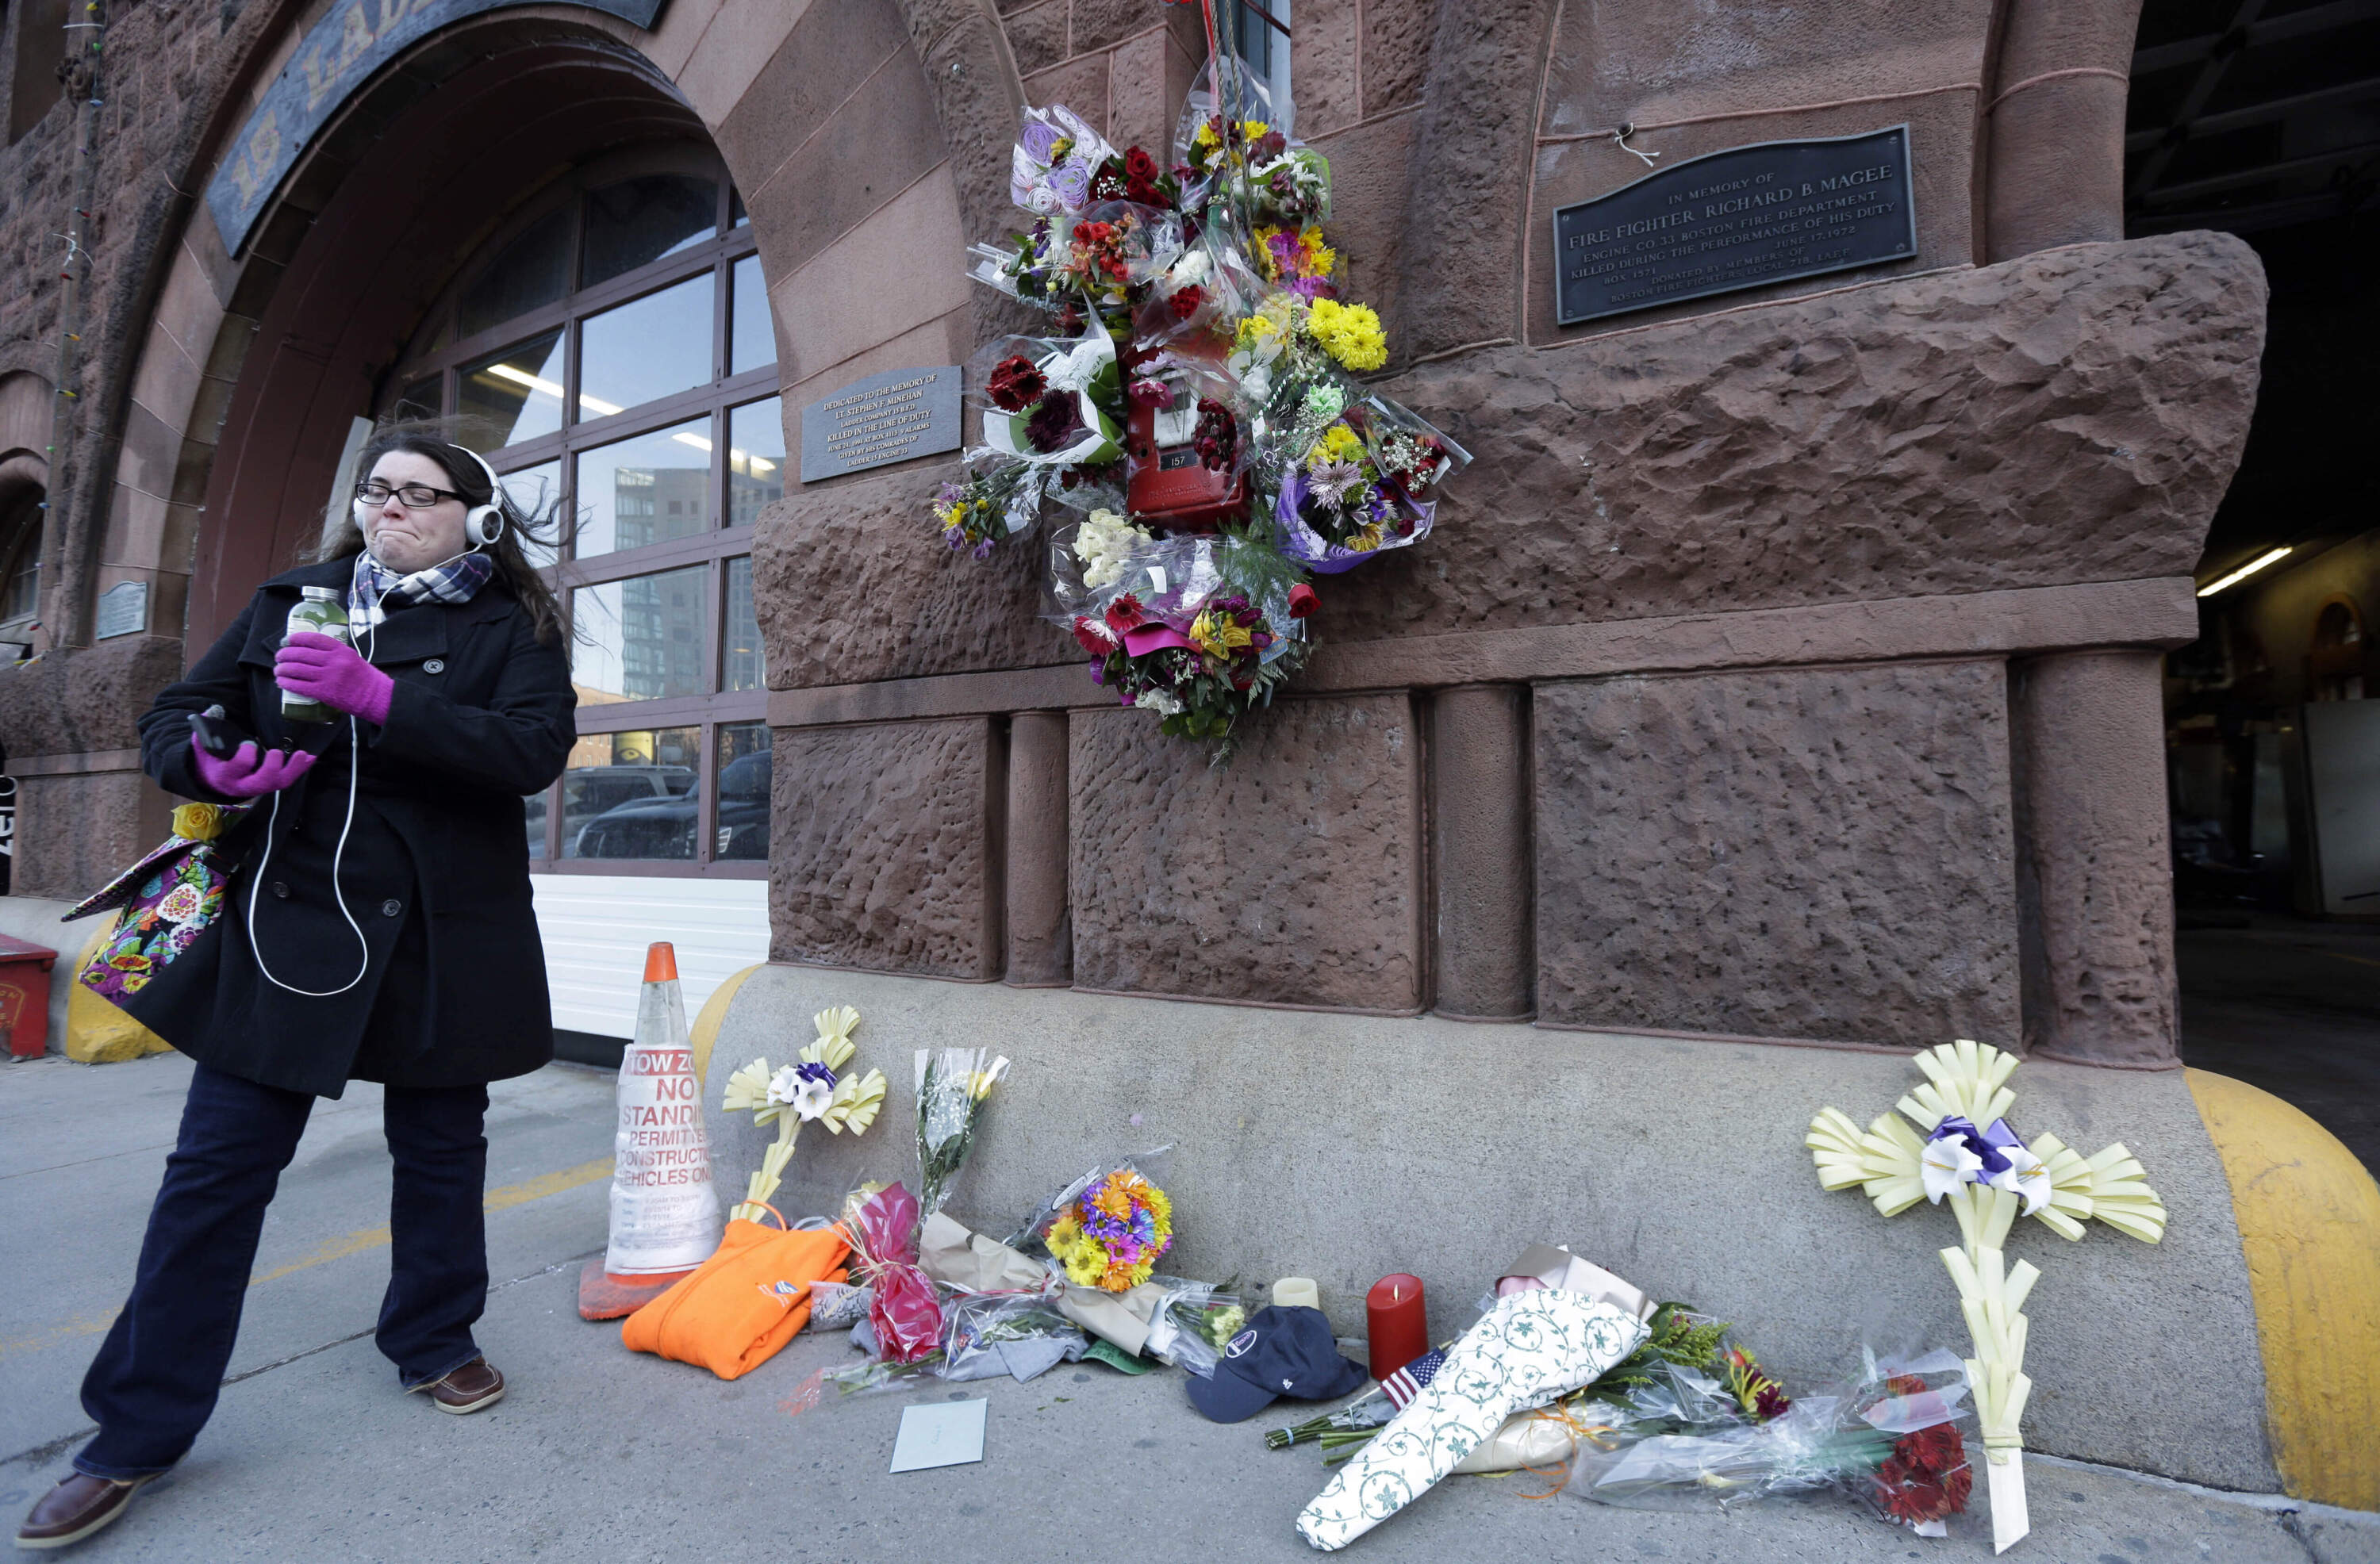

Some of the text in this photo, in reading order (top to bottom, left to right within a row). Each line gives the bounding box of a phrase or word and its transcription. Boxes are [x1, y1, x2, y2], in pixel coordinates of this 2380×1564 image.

[230, 0, 436, 212] 15 LAD
[1668, 172, 1775, 205] IN MEMORY OF
[1569, 165, 1893, 249] FIRE FIGHTER RICHARD B. MAGEE
[1571, 201, 1895, 279] KILLED DURING THE PERFORMANCE OF HIS DUTY
[1583, 246, 1630, 263] ENGINE
[1682, 221, 1733, 241] BOSTON
[1741, 214, 1772, 228] FIRE
[1779, 190, 1877, 220] DEPARTMENT
[1775, 236, 1806, 249] JUNE
[1604, 268, 1656, 286] BOX 1571
[1651, 247, 1806, 285] DONATED BY MEMBERS OF
[1611, 288, 1654, 303] BOSTON
[1656, 281, 1683, 294] FIRE
[1746, 262, 1784, 275] LOCAL
[823, 374, 937, 412] DEDICATED TO THE MEMORY OF
[847, 401, 878, 417] STEPHEN
[888, 389, 923, 406] MINEHAN
[827, 409, 931, 443] KILLED IN THE LINE OF DUTY
[841, 417, 864, 428] LADDER
[864, 409, 893, 422] COMPANY
[828, 443, 841, 453] JUNE
[872, 433, 885, 442] BOX
[905, 422, 931, 434] ALARMS
[838, 434, 919, 460] GIVEN BY HIS COMRADES OF
[847, 457, 870, 467] LADDER
[878, 449, 900, 459] ENGINE
[1172, 457, 1184, 466] 157
[628, 1052, 674, 1074] TOW
[656, 1076, 694, 1102] NO
